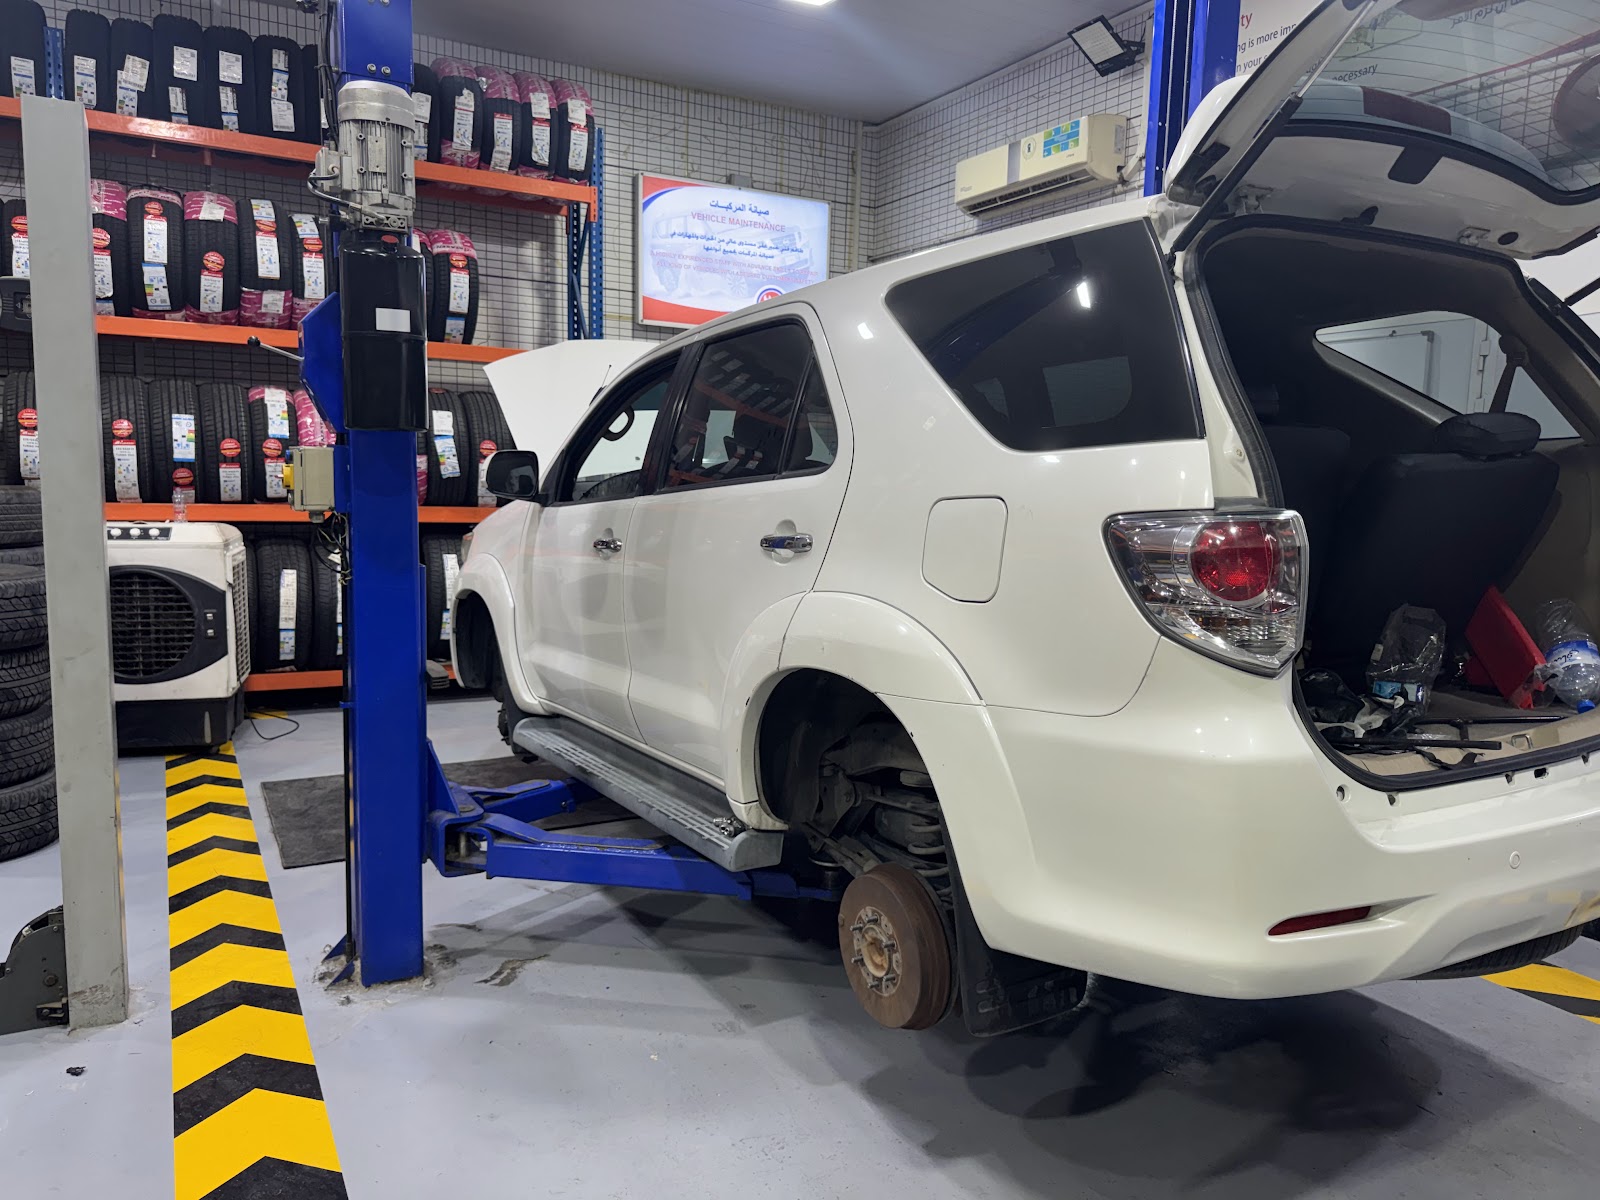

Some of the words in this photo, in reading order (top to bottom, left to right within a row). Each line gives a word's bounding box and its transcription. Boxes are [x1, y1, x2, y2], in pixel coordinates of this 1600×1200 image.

[1248, 38, 1255, 48] is
[1256, 30, 1278, 46] more
[1243, 58, 1261, 73] your
[709, 200, 747, 214] المركبات
[748, 204, 770, 216] صيانة
[691, 211, 726, 224] VEHICLE
[728, 217, 786, 233] MAINTENANCE
